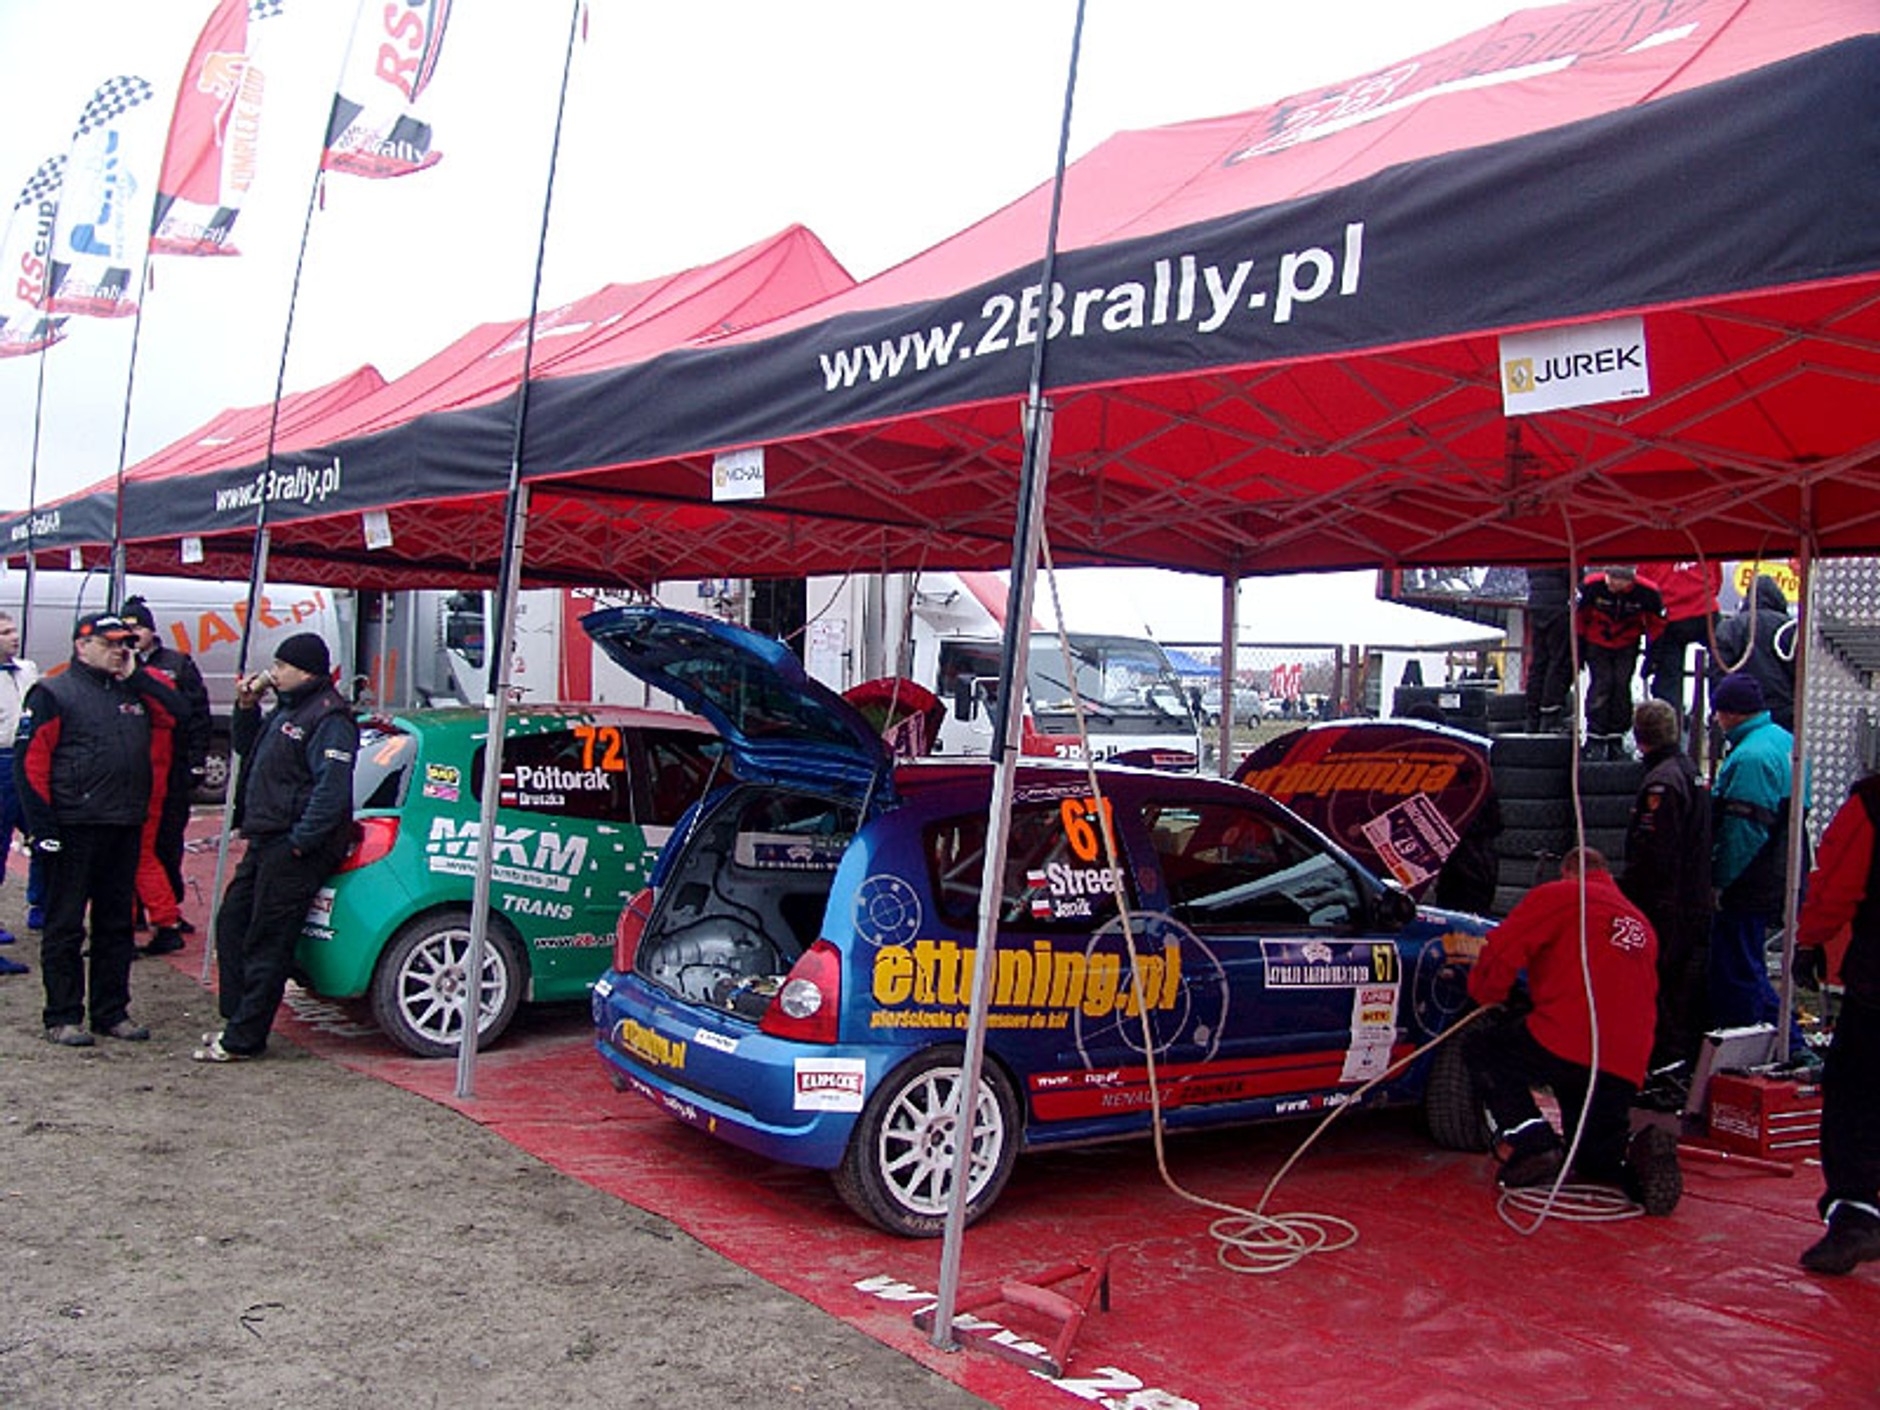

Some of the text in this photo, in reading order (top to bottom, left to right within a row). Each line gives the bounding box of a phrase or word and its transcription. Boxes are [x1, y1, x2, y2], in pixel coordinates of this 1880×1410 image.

[818, 222, 1365, 392] www.2Brally.pl
[1534, 344, 1642, 384] JUREK
[574, 726, 625, 771] 72
[515, 765, 611, 791] Półtorak
[426, 816, 589, 876] MKM
[1061, 797, 1118, 861] 67
[504, 893, 575, 921] TRANS
